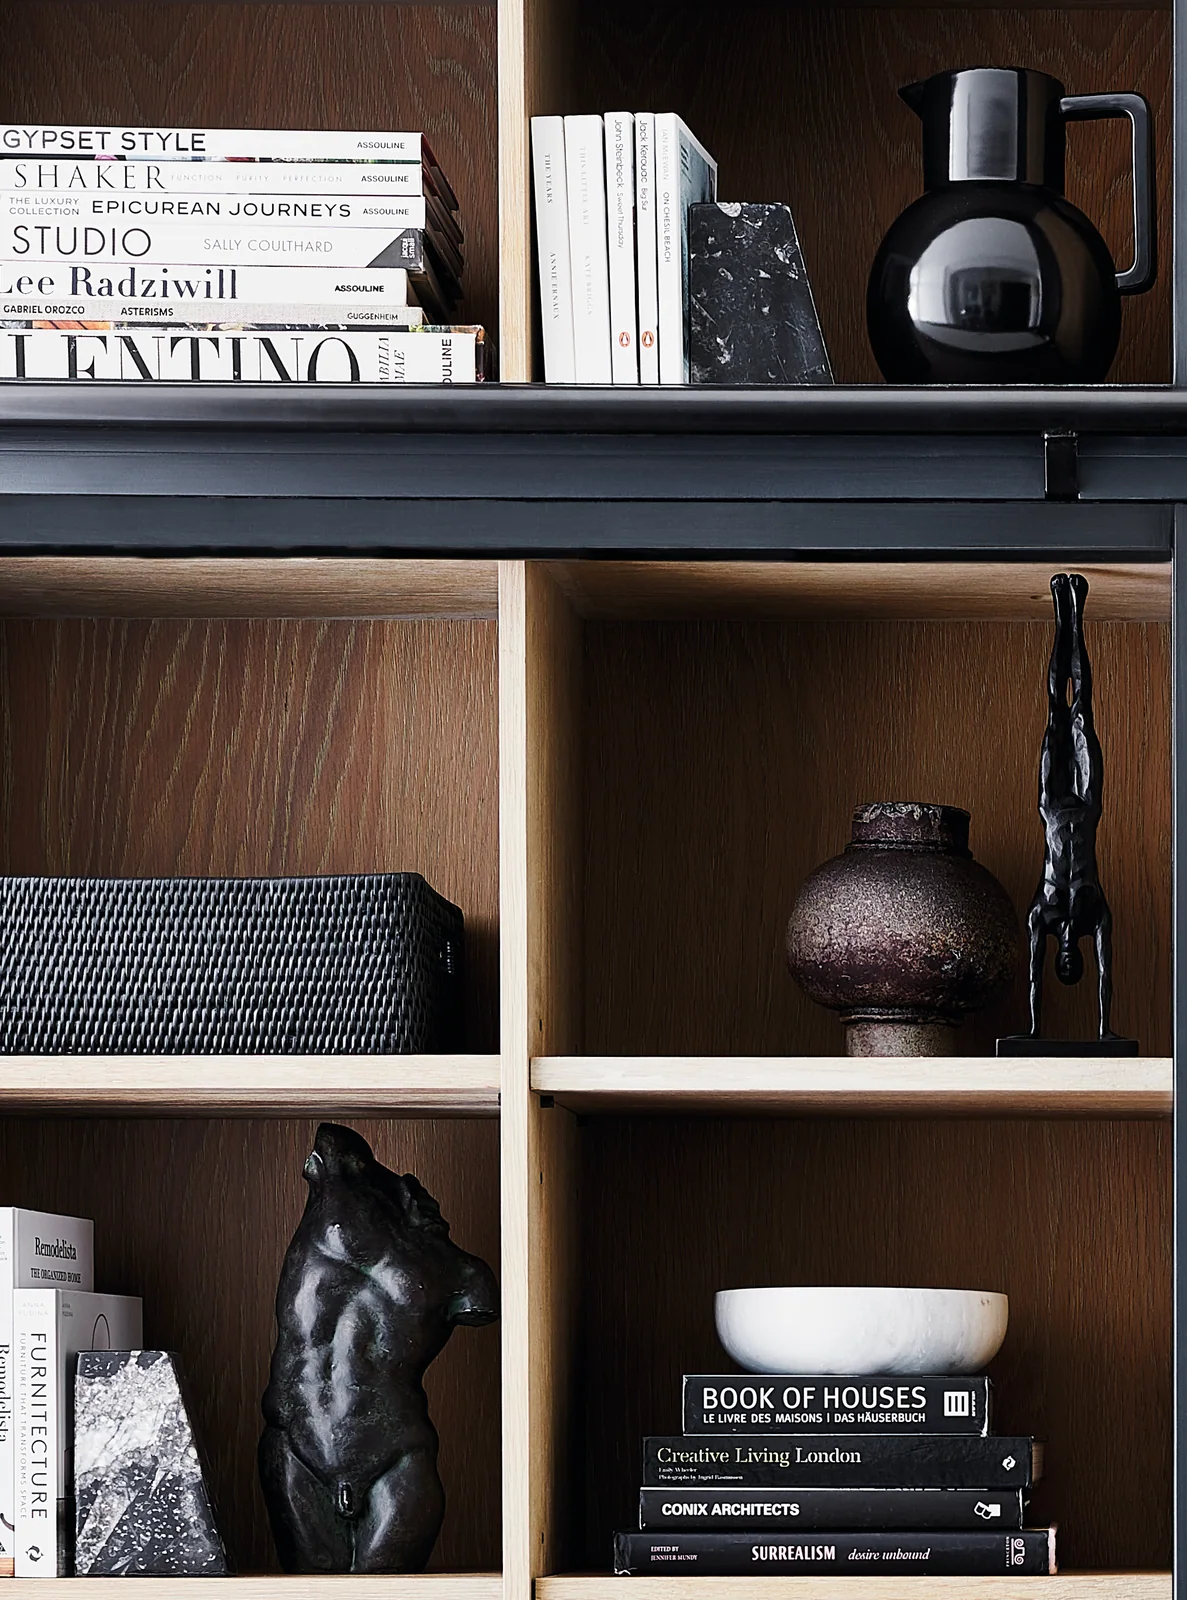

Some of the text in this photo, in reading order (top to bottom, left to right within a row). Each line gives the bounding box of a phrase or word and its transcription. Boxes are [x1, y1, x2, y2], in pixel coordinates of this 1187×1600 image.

[3, 129, 206, 151] GYPSET STYLE
[614, 120, 624, 188] John Steinbeck
[639, 120, 648, 183] Jack Kerouac
[15, 164, 166, 189] SHAKER
[9, 197, 79, 206] THE LUXURY
[92, 200, 351, 217] EPICUREAN JOURNEYS
[663, 192, 670, 205] ON
[9, 207, 80, 215] COLLECTION
[663, 207, 671, 234] CHESIL
[12, 225, 333, 257] STUDIO SALLY COULTHARD
[69, 266, 238, 299] Radziwill
[4, 305, 174, 316] GABRIEL OROZCO ASTERISMS
[347, 312, 398, 320] GUGGENHEIM
[35, 1237, 77, 1260] Remodelista
[703, 1386, 927, 1409] BOOK OF HOUSES
[31, 1333, 47, 1519] FURNITECTURE
[703, 1411, 926, 1424] LE LIVRE DES MAISONS DAS HÄUSERBUCH
[657, 1447, 861, 1467] Creative Living London
[662, 1504, 800, 1516] CONIX ARCHITECTS
[751, 1545, 931, 1561] SURREALISM desire unbound
